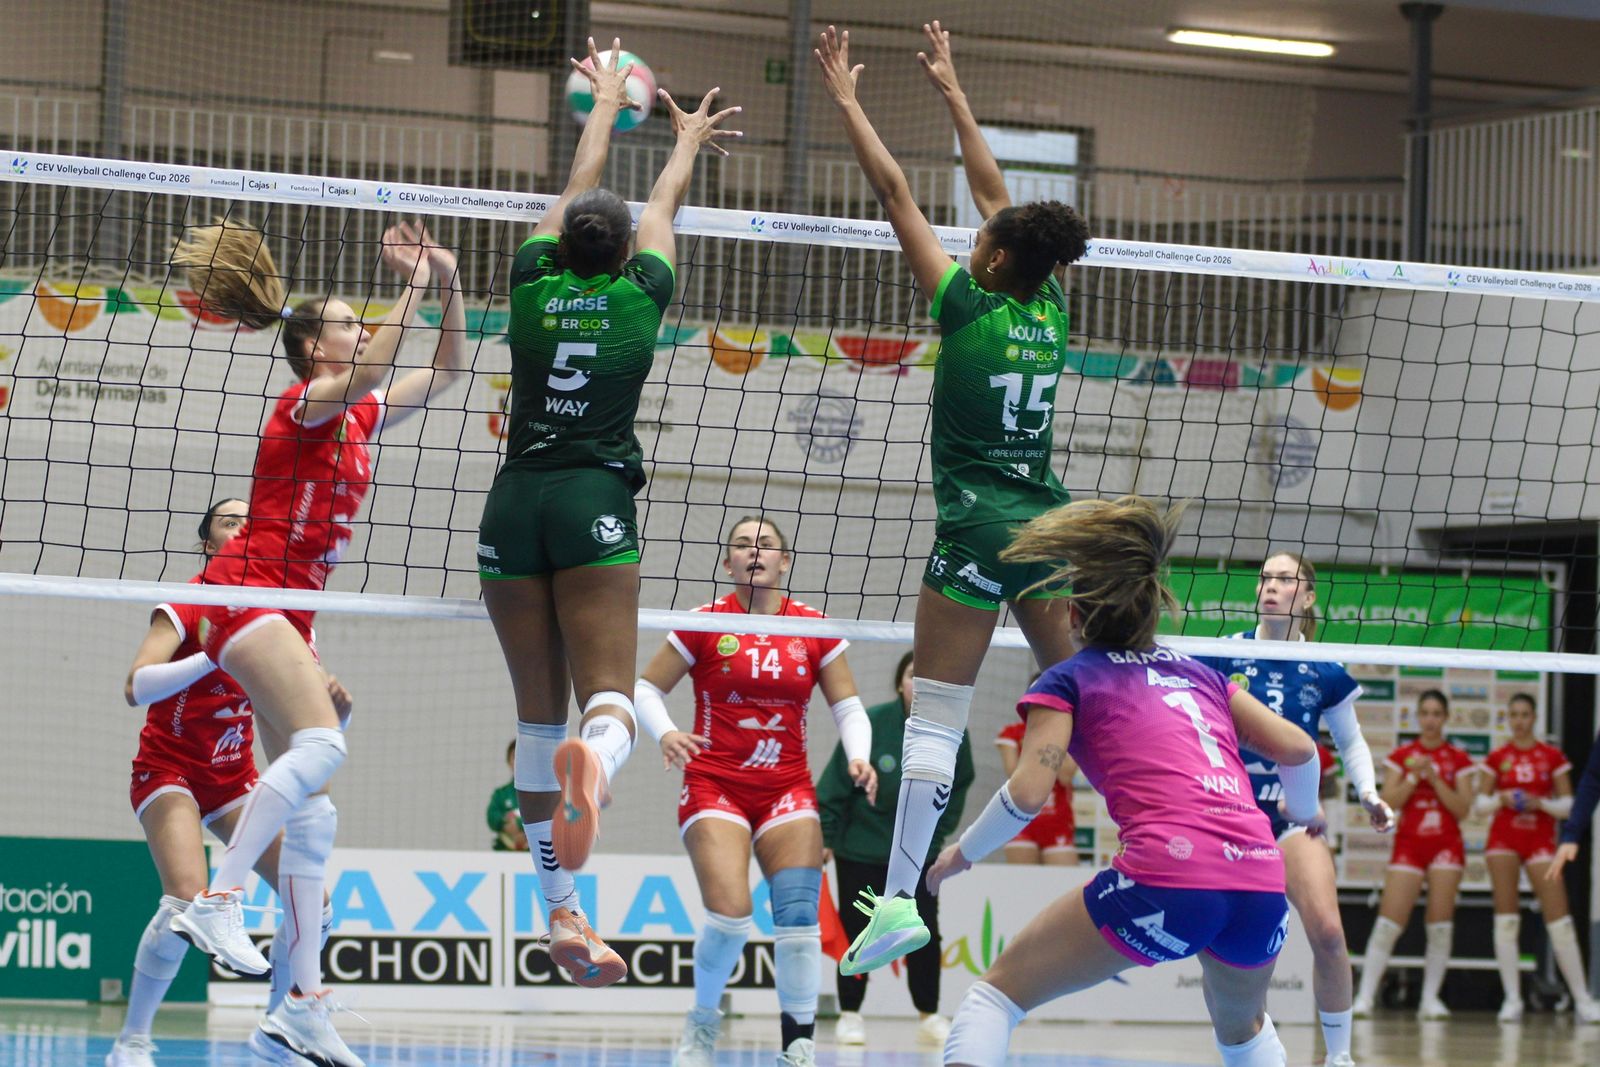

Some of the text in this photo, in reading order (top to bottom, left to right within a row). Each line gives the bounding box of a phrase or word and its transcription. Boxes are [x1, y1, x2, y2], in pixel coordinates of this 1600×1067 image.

[36, 162, 191, 184] CEV Volleyball Challenge Cup 2026
[399, 192, 546, 211] CEV Volleyball Challenge Cup 2026
[772, 221, 789, 231] CEV
[791, 222, 830, 235] Volleyball
[832, 225, 873, 237] Challenge
[874, 229, 891, 239] Cup
[1098, 246, 1232, 265] CEV Volleyball Challenge Cup 2026
[1466, 274, 1592, 292] CEV Volleyball Challenge Cup 2026
[561, 318, 610, 329] ERGOS
[1008, 324, 1058, 343] LOUISE
[1022, 350, 1058, 361] ERGOS
[547, 342, 597, 391] 5
[36, 380, 167, 404] Dos Hermanas
[545, 396, 590, 416] WAY
[745, 647, 783, 680] 14
[1162, 691, 1226, 769] 1
